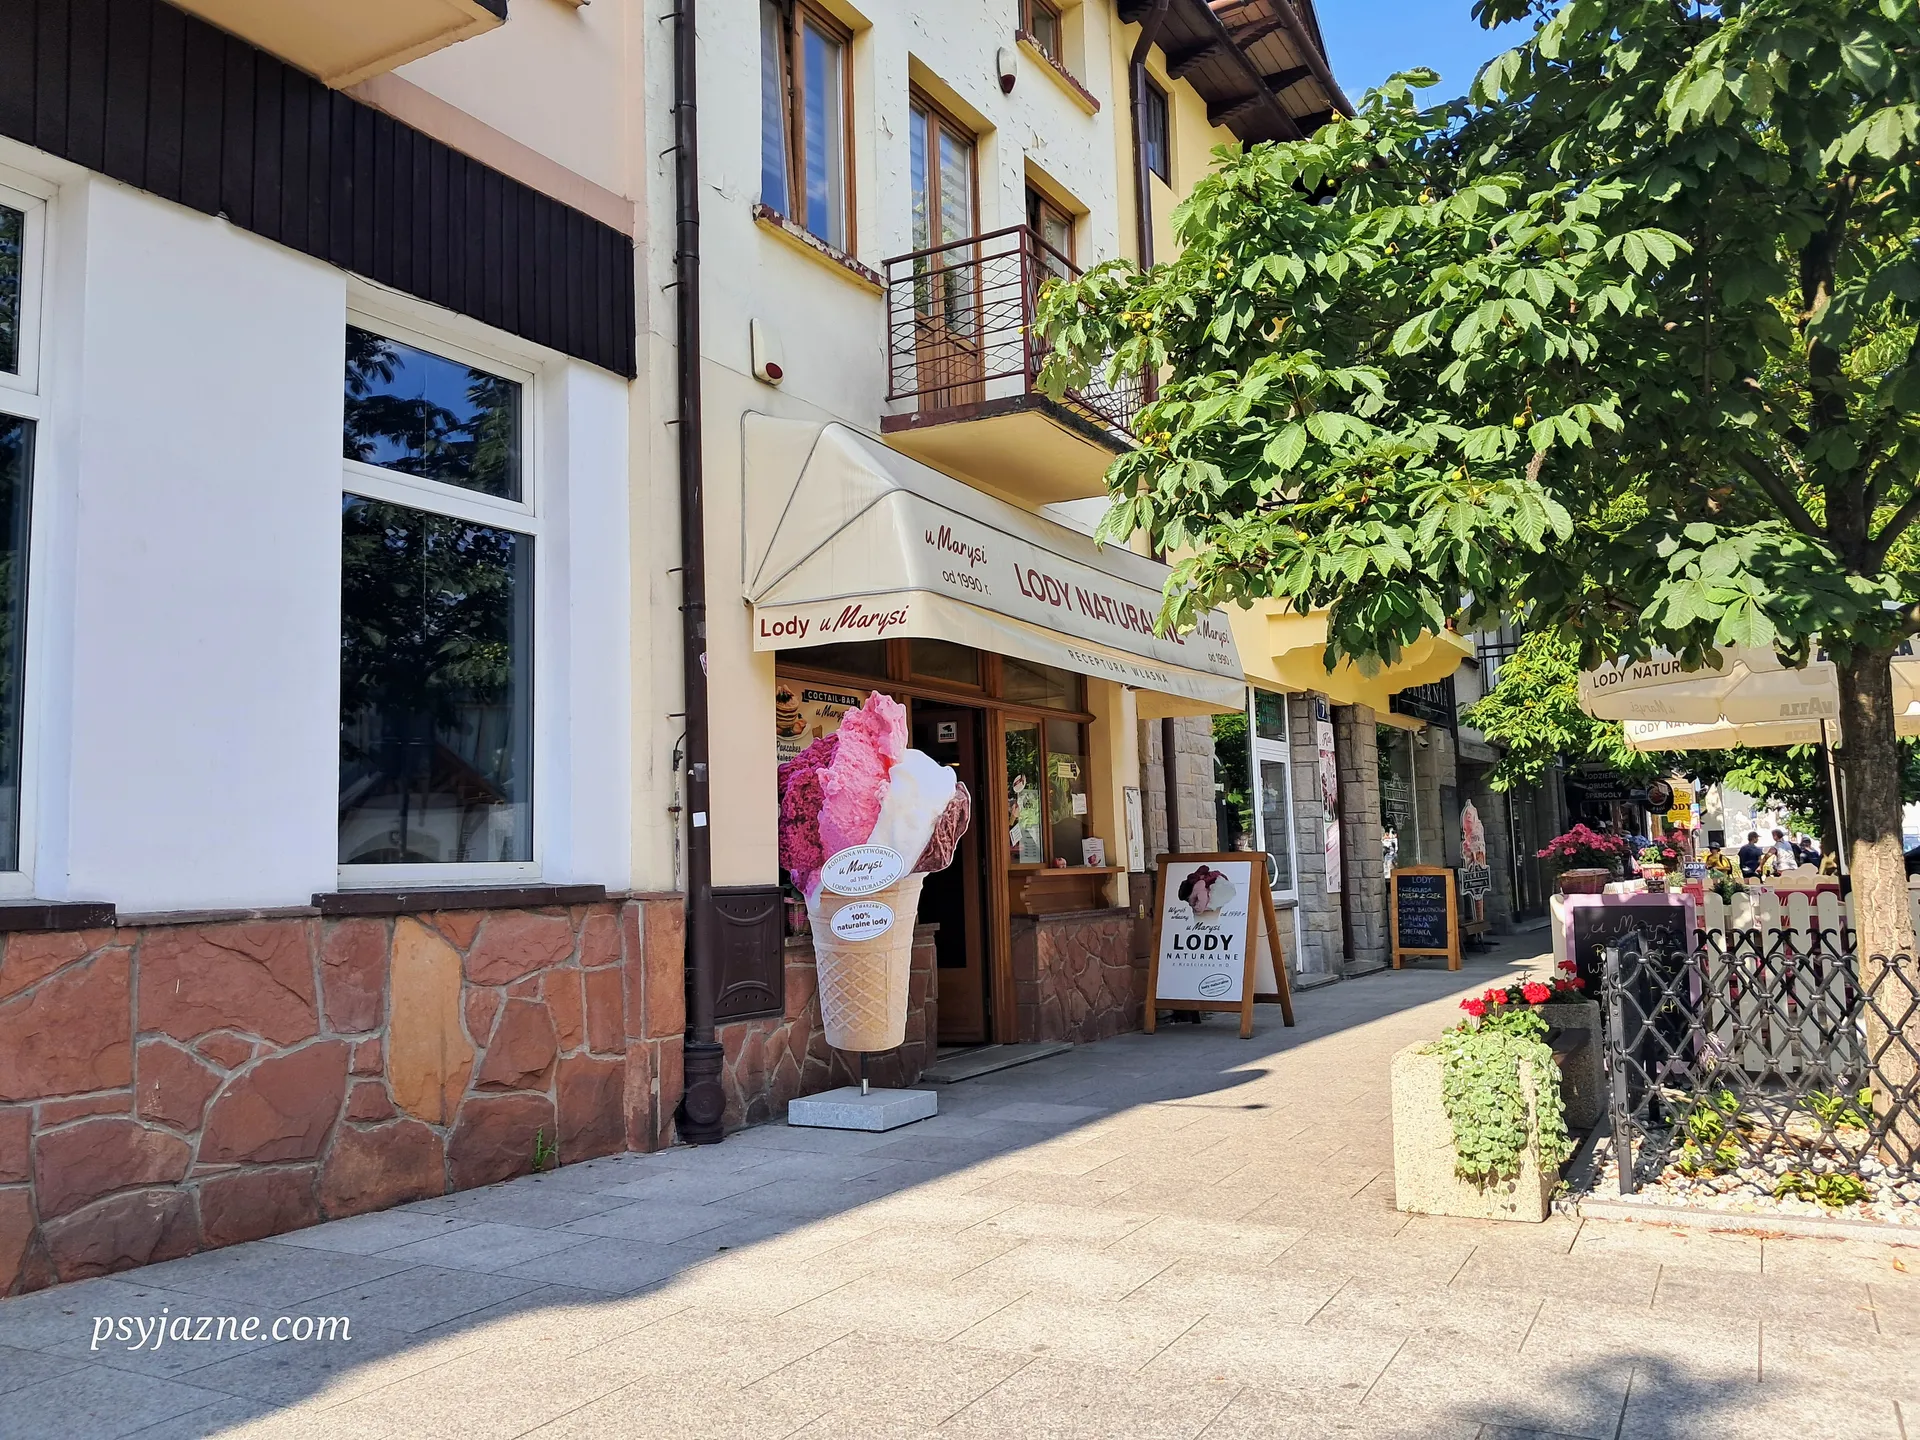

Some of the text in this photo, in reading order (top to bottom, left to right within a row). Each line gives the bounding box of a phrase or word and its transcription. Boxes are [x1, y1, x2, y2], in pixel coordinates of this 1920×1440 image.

[925, 525, 987, 568] u Marysi
[942, 570, 956, 584] od
[957, 572, 982, 593] 1990
[1013, 563, 1072, 611] LODY
[760, 604, 909, 638] Lody u Marysi
[1202, 620, 1230, 648] Marysi
[1068, 649, 1127, 674] RECEPTURA
[1215, 653, 1229, 667] 1990
[1592, 671, 1625, 689] LODY
[807, 691, 856, 705] COCTAIL-BAR
[1634, 722, 1660, 735] LODY
[827, 848, 894, 870] RODZINNA WYTWÓRNIA
[838, 857, 884, 875] u Marysi
[853, 872, 895, 892] NATURALNYCH
[837, 918, 888, 931] naturalne lody
[851, 912, 871, 920] 100%
[1192, 922, 1221, 933] Marysi
[1173, 934, 1233, 950] LODY
